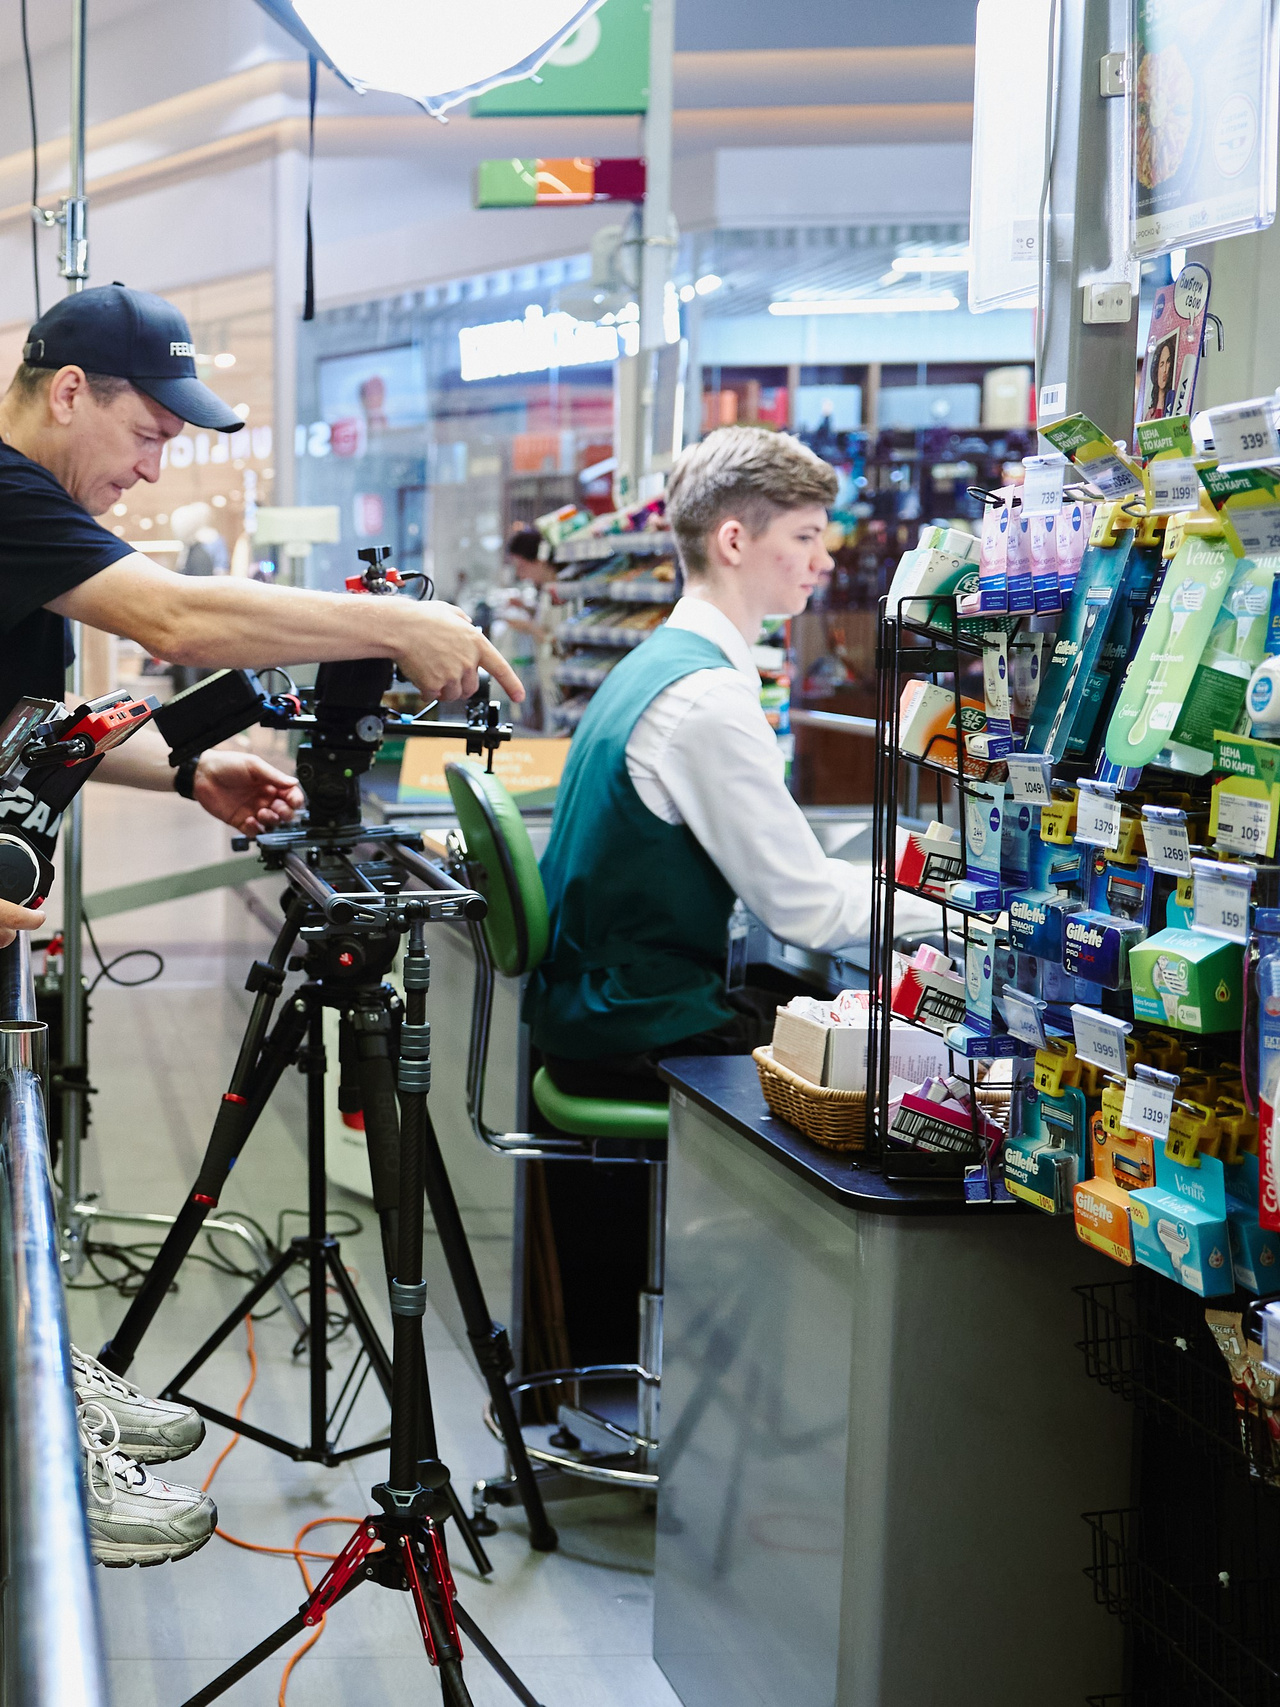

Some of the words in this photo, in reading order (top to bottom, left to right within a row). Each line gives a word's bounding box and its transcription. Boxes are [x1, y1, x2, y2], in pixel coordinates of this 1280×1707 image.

[1179, 273, 1204, 296] Выбери
[1141, 429, 1160, 440] ЦЕНА
[1154, 437, 1174, 449] КАРТЕ
[1241, 433, 1265, 450] 339
[1225, 478, 1252, 490] КАРТЕ
[1041, 492, 1056, 505] 739
[1172, 487, 1190, 500] 1199
[1185, 543, 1225, 566] Venus
[1055, 640, 1078, 655] Gillette
[965, 709, 985, 724] tic
[1220, 745, 1241, 759] ЦЕНА
[1220, 757, 1231, 769] ПО
[1231, 760, 1256, 776] КАРТЕ
[1025, 782, 1042, 794] 1049
[1094, 818, 1114, 835] 1379
[1241, 826, 1259, 841] 109
[1163, 846, 1184, 861] 1269
[1010, 901, 1045, 925] Gillette
[1221, 910, 1240, 928] 159
[1066, 922, 1103, 948] Gillette
[1093, 1041, 1114, 1058] 1999
[1142, 1107, 1163, 1123] 1319
[1005, 1147, 1039, 1175] Gillette
[1174, 1173, 1206, 1203] Venus
[1037, 1194, 1053, 1211] -10%
[1075, 1191, 1113, 1224] Gillette
[1111, 1243, 1130, 1262] -10%
